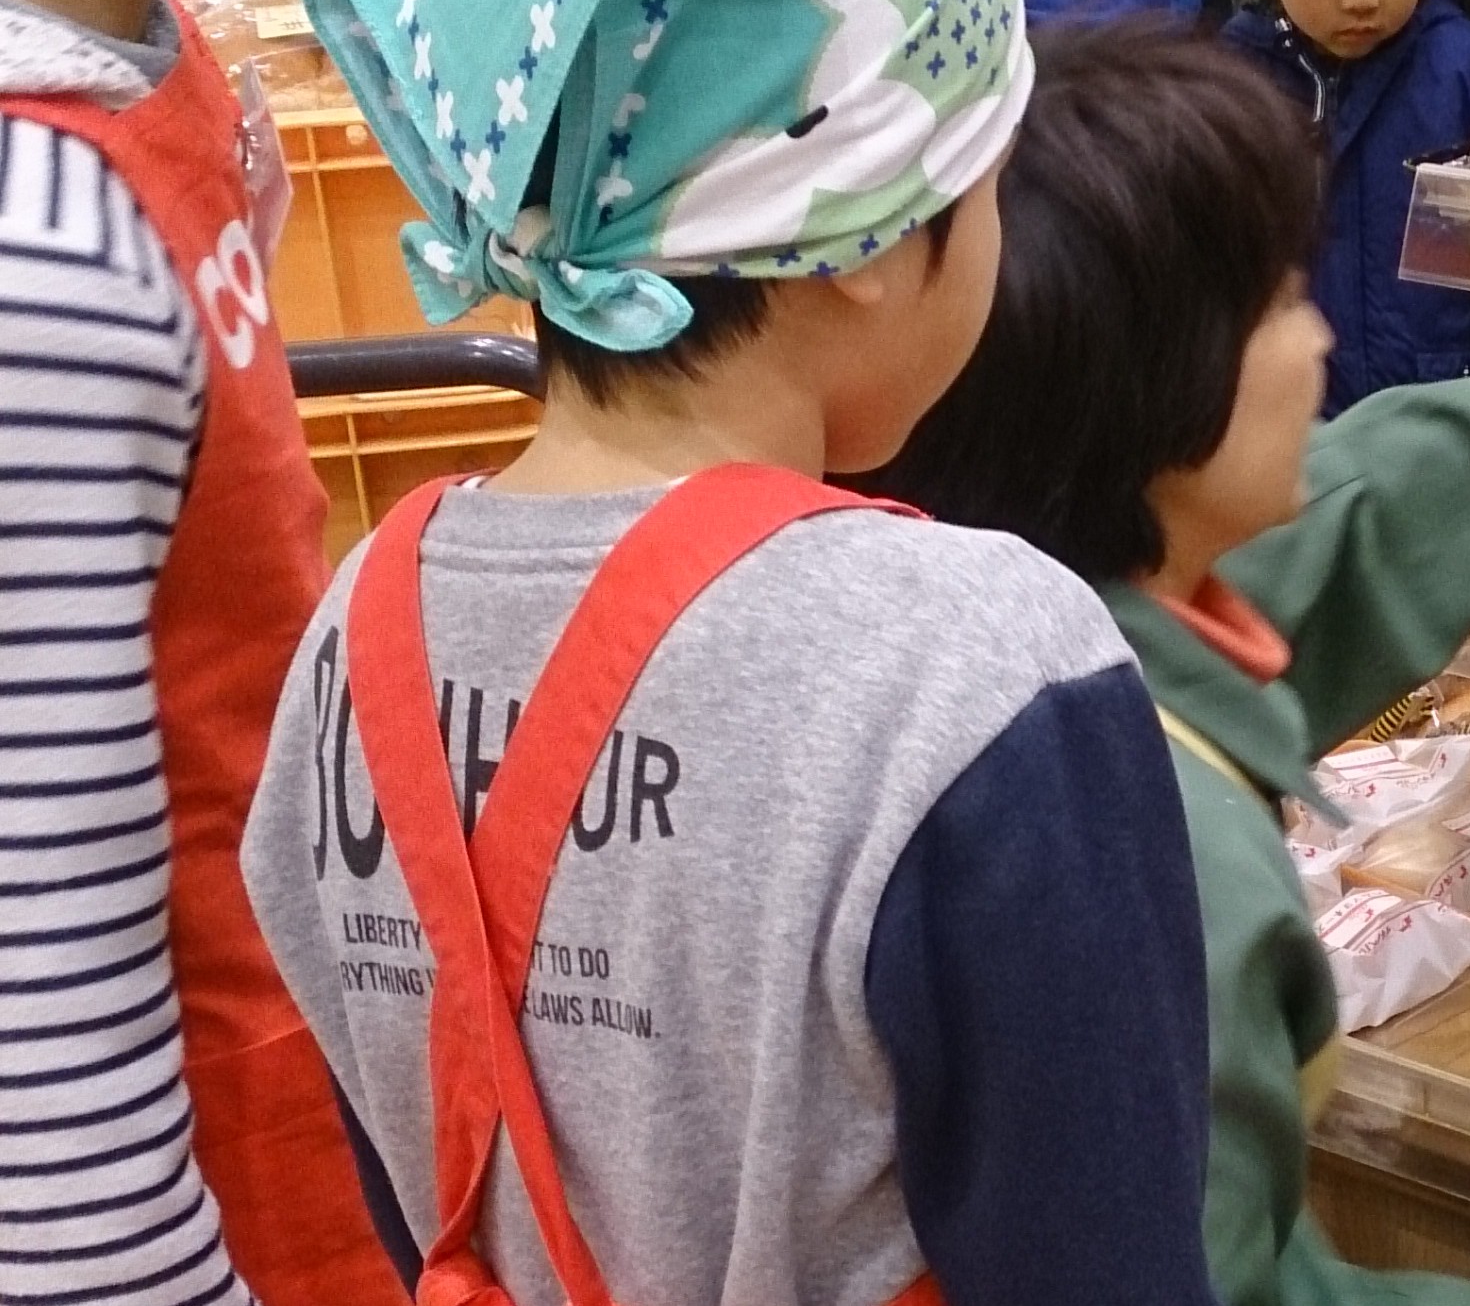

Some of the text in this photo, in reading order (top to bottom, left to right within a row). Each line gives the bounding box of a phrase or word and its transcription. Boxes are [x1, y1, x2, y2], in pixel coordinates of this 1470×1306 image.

[343, 912, 421, 950] LIBERTY
[547, 943, 572, 977] TO
[578, 947, 610, 980] DO
[531, 992, 584, 1026] LAWS
[590, 999, 662, 1039] ALLOW.
